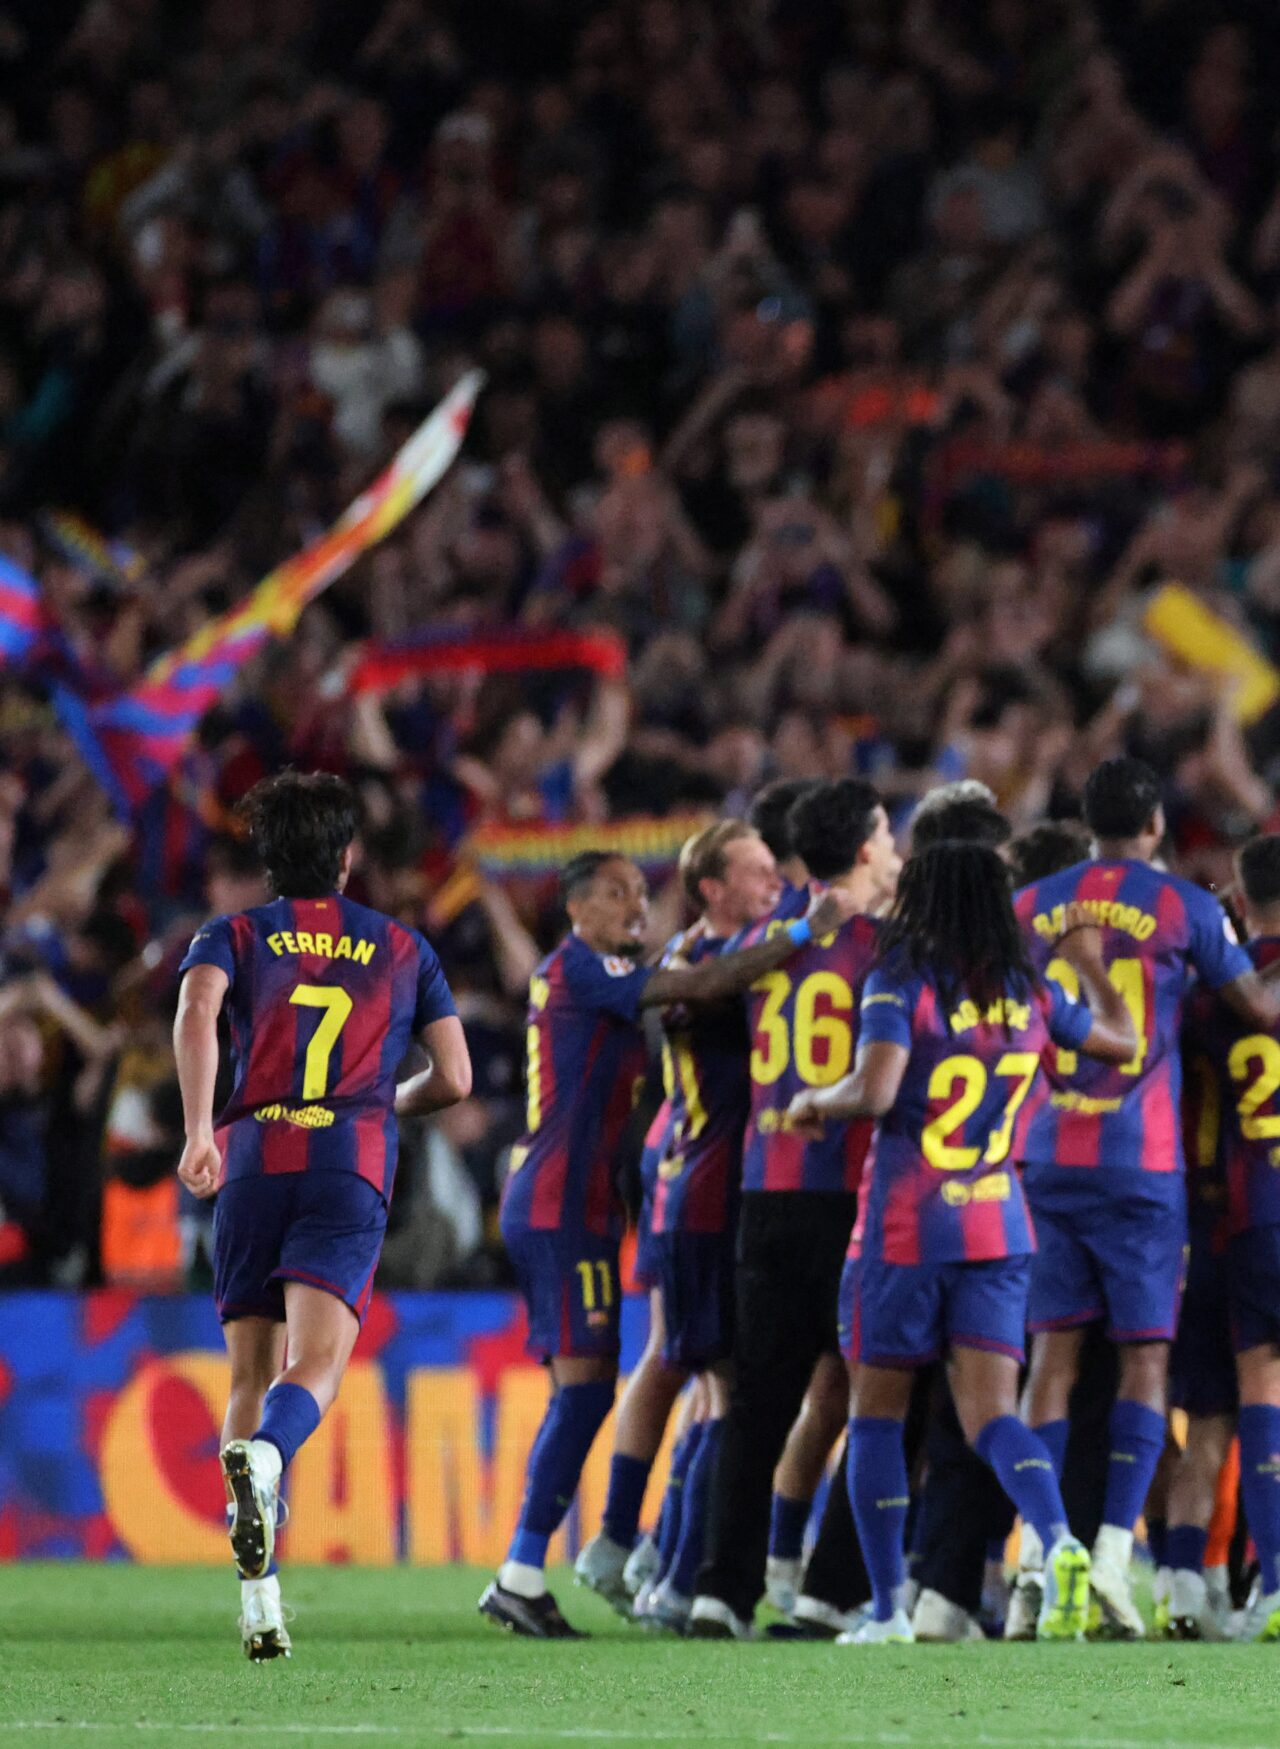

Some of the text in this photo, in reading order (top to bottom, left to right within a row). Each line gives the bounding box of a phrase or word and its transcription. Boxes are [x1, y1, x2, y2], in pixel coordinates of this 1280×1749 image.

[266, 931, 376, 965] FERRAN
[288, 983, 353, 1100] 7
[749, 970, 854, 1087] 36
[920, 1052, 1041, 1171] 27
[576, 1261, 613, 1310] 11
